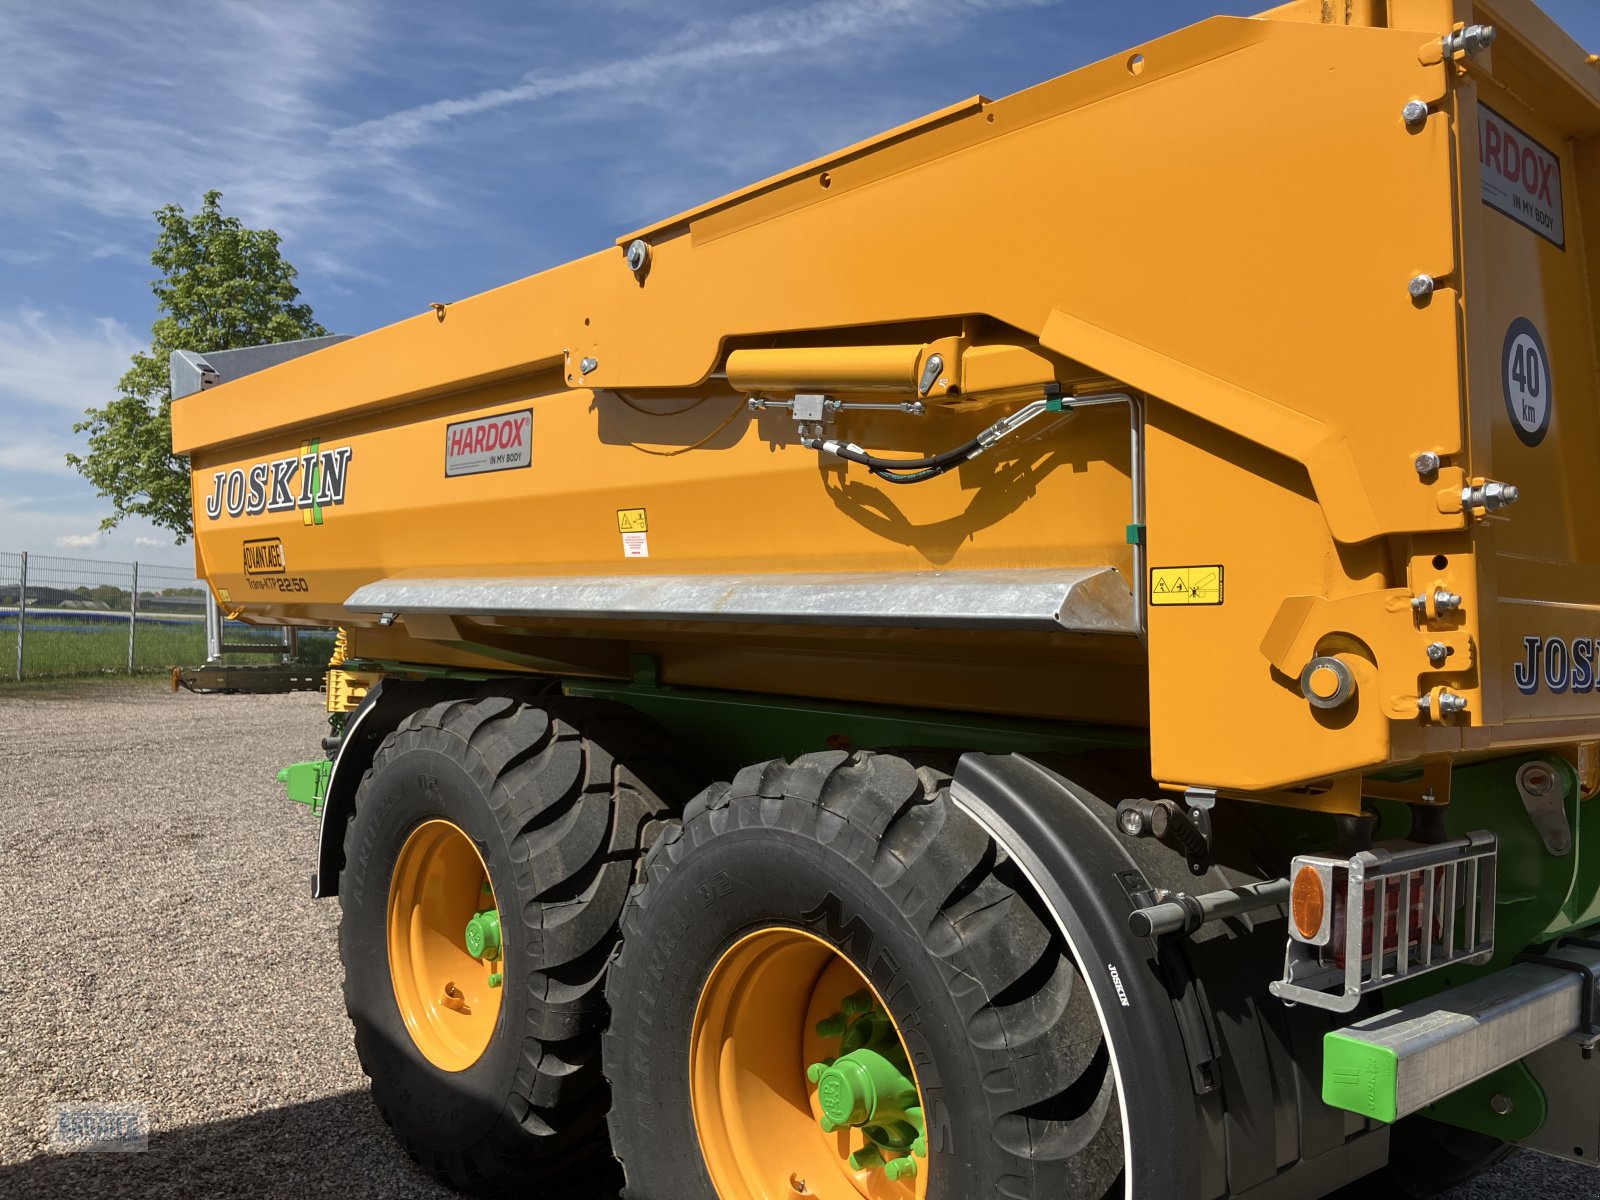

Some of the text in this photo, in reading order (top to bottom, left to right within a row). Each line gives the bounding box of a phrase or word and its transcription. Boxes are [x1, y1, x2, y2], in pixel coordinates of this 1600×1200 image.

[1512, 193, 1554, 230] IN MY BODY
[1512, 343, 1540, 397] 40
[1522, 399, 1536, 423] km
[490, 451, 522, 464] IN MY BODY
[206, 446, 352, 520] JOSKIN
[244, 544, 282, 574] ADVANTAGE
[1513, 636, 1600, 695] JOS
[1108, 963, 1130, 1007] JOSKIN
